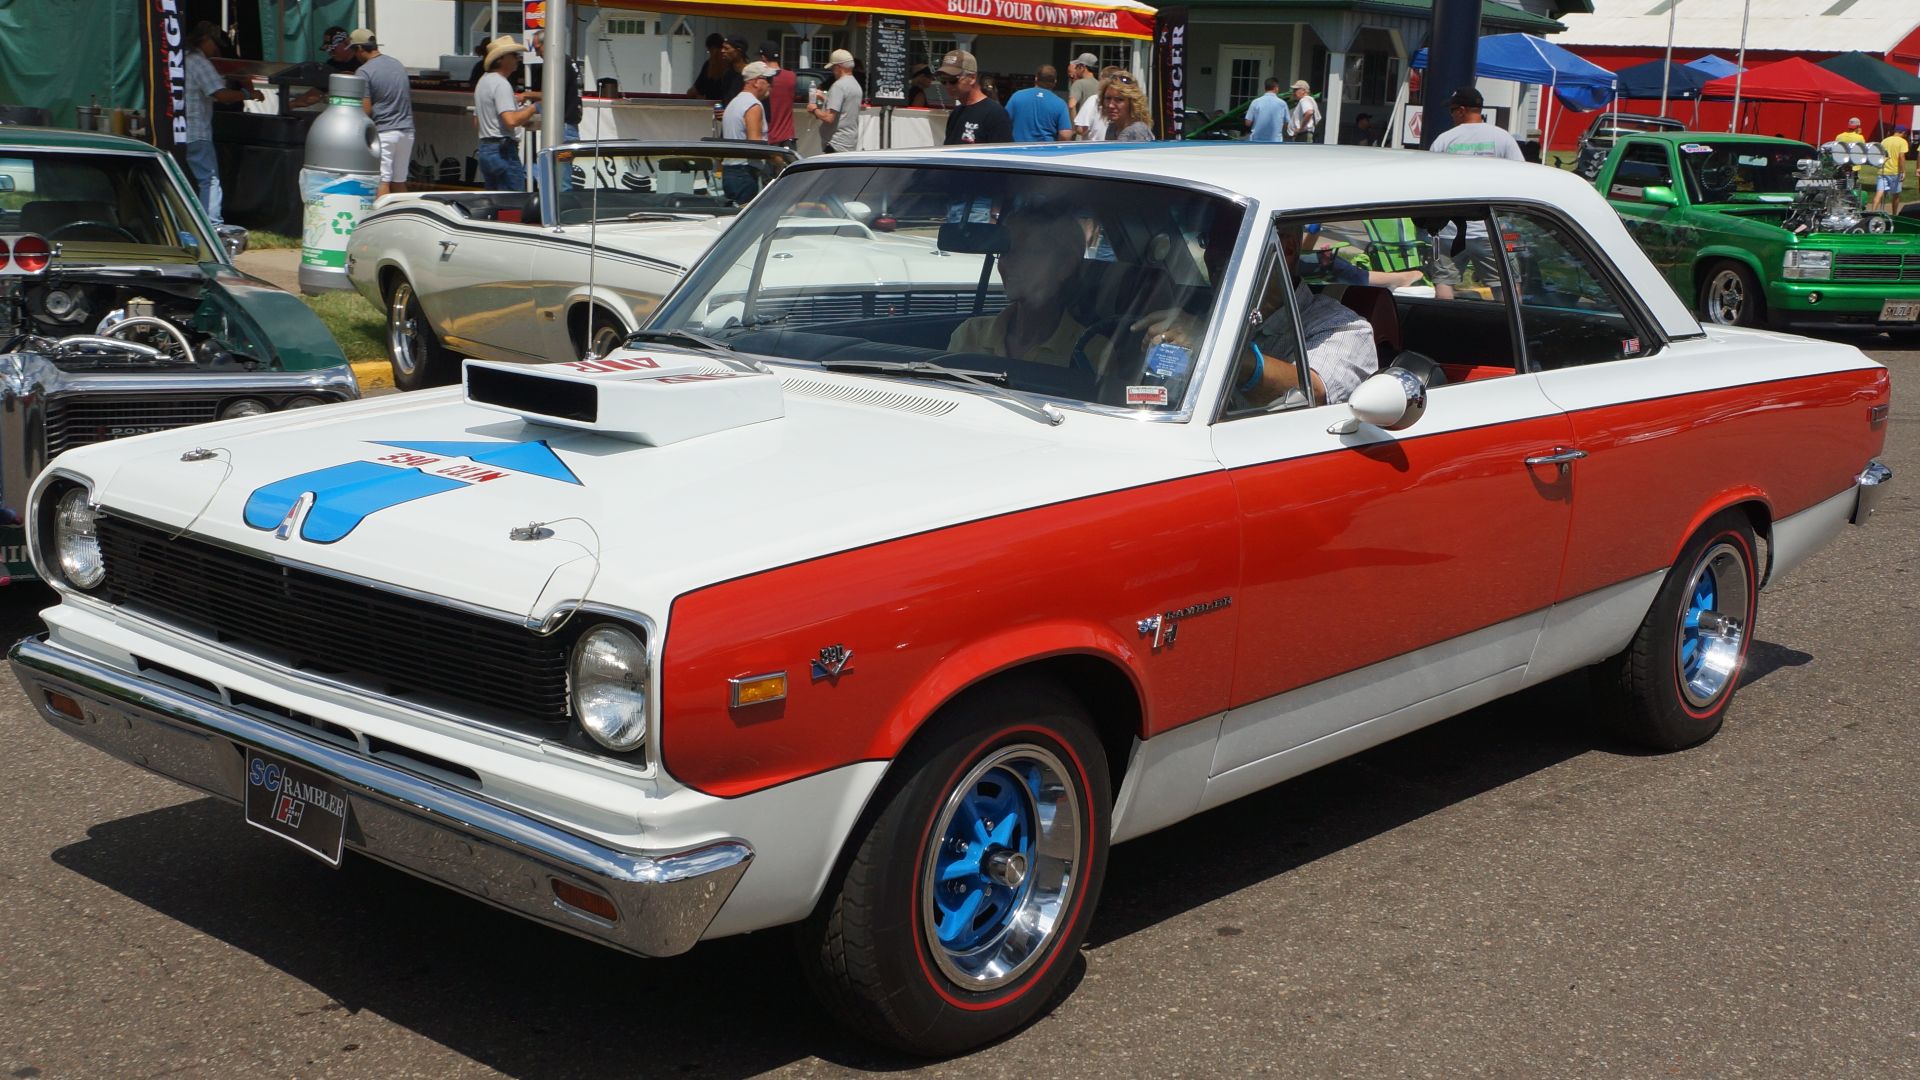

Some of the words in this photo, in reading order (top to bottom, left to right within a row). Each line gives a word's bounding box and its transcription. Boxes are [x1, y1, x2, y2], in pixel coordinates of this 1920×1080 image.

[947, 0, 991, 16] BUILD
[995, 1, 1032, 21] YOUR
[1035, 5, 1068, 24] OWN
[1071, 10, 1118, 29] BURGER
[377, 452, 441, 466] 390
